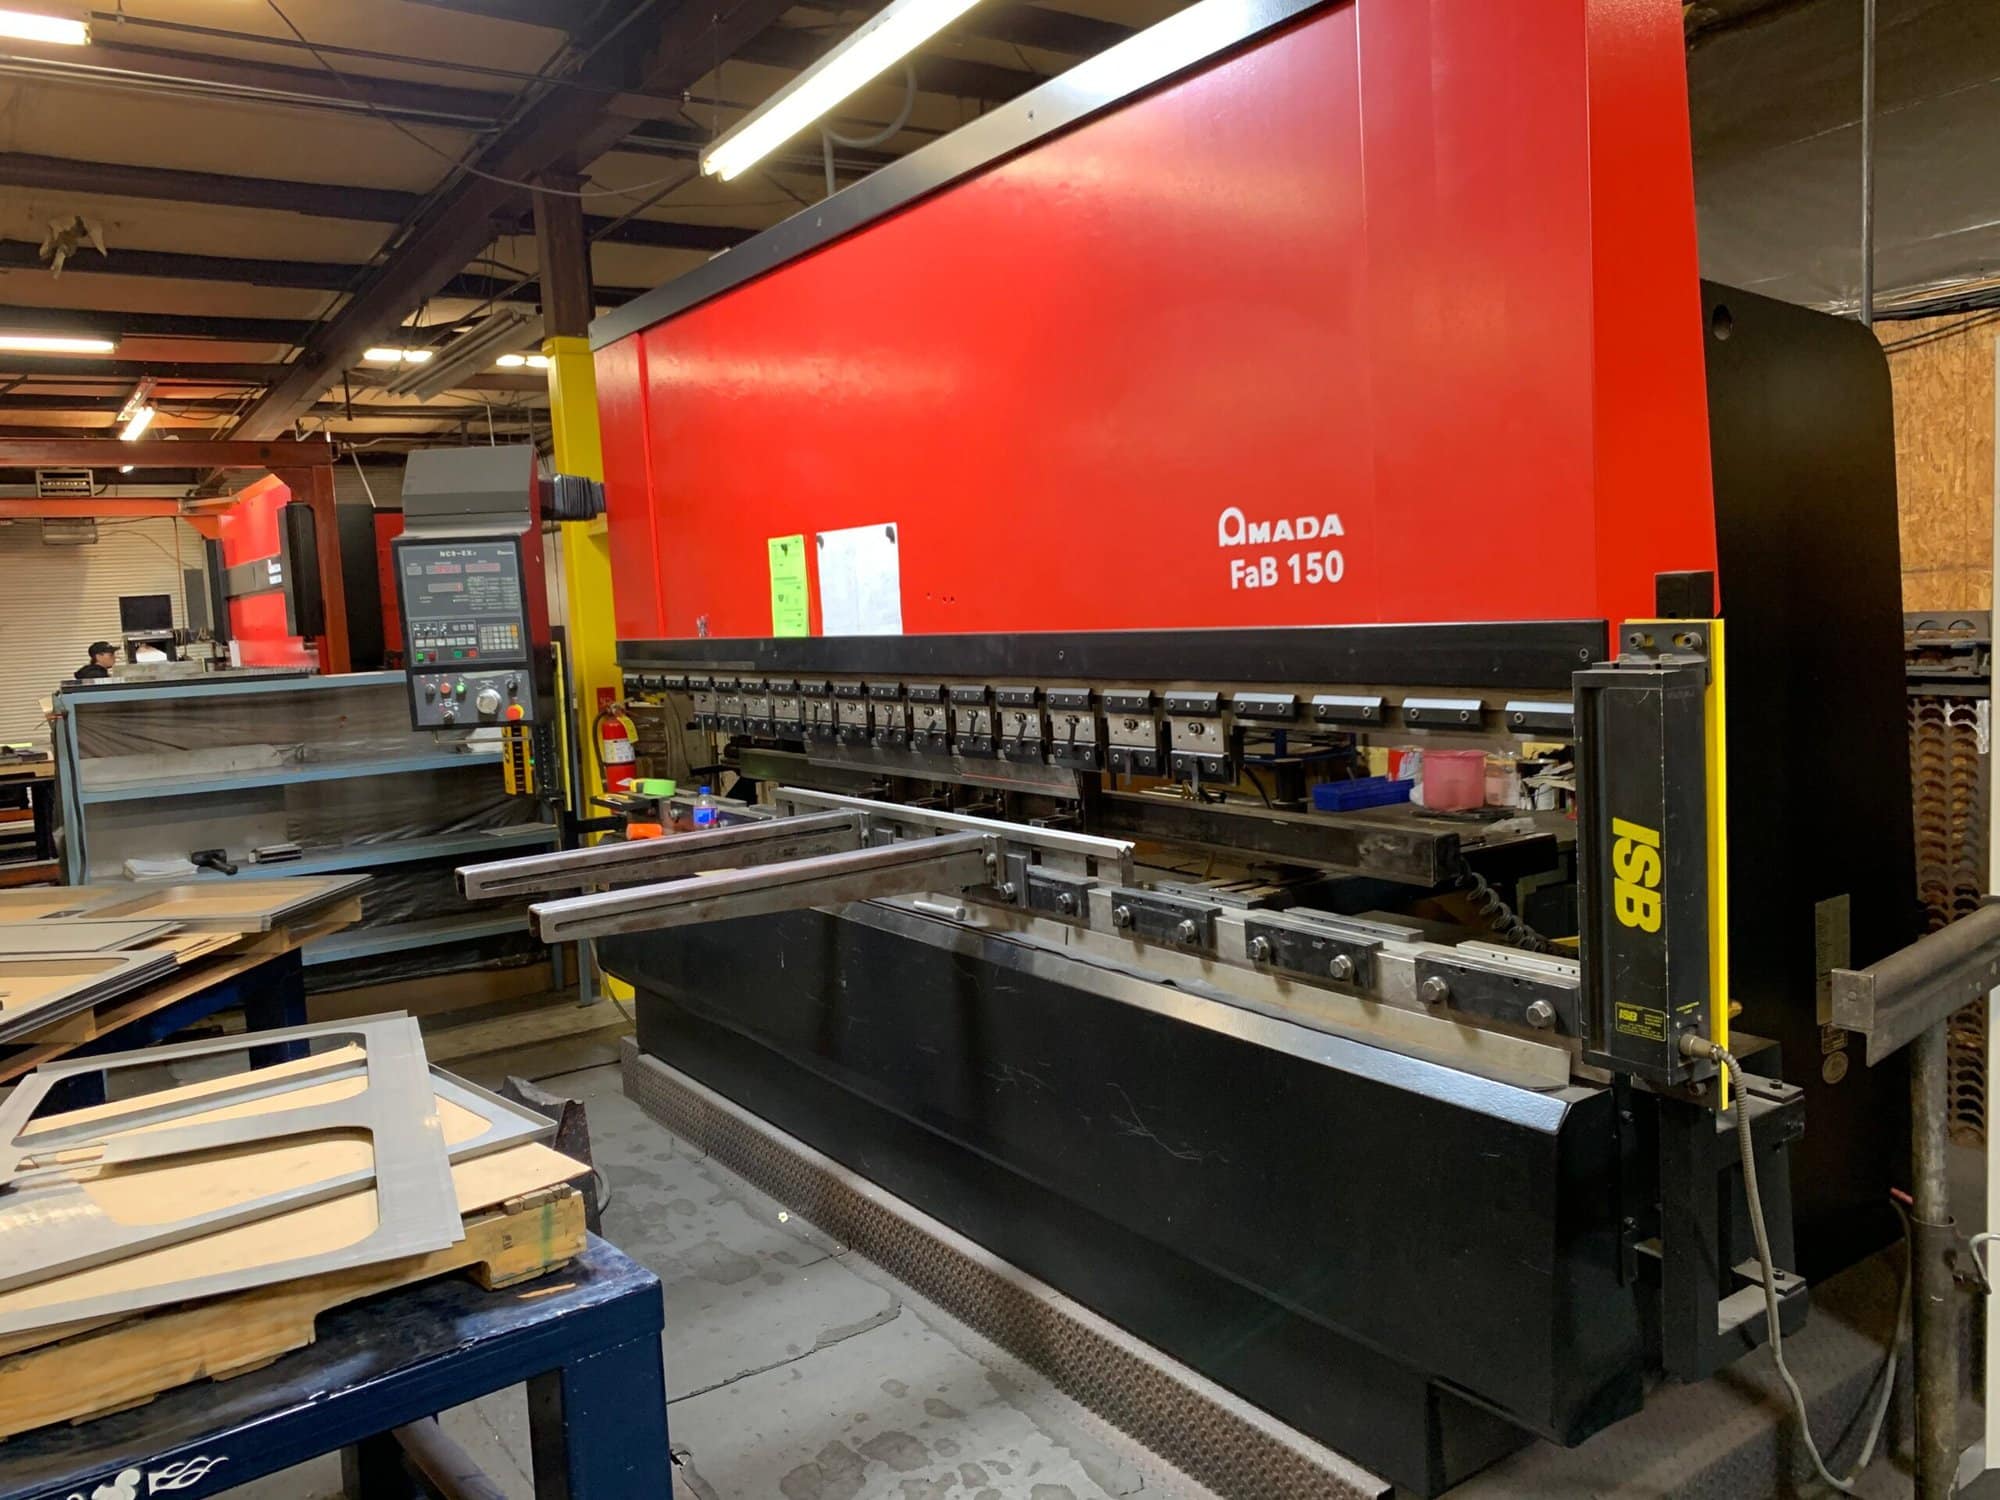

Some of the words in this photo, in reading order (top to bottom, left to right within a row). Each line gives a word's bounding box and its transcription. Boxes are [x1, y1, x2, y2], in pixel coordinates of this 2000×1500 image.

[1230, 555, 1279, 590] FaB
[1287, 549, 1344, 585] 150
[1612, 817, 1662, 933] ISB
[1618, 1008, 1638, 1022] ISB
